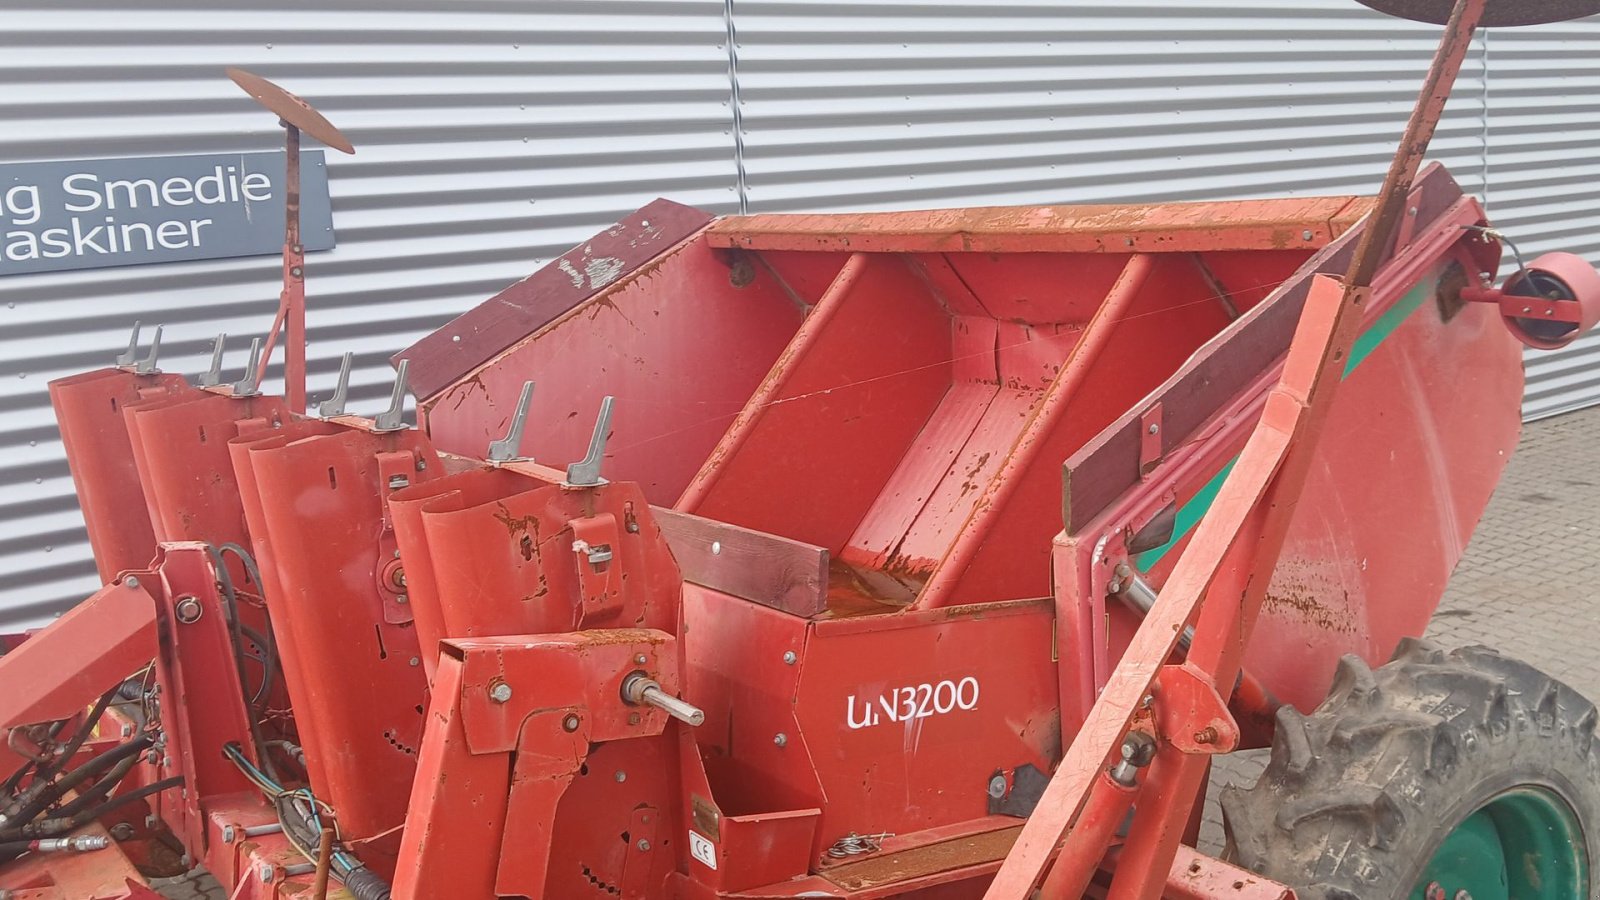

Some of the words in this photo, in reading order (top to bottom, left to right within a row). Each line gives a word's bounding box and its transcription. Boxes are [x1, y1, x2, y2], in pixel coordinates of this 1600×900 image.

[0, 184, 42, 225] g
[62, 165, 272, 213] Smedie
[0, 216, 213, 262] askiner
